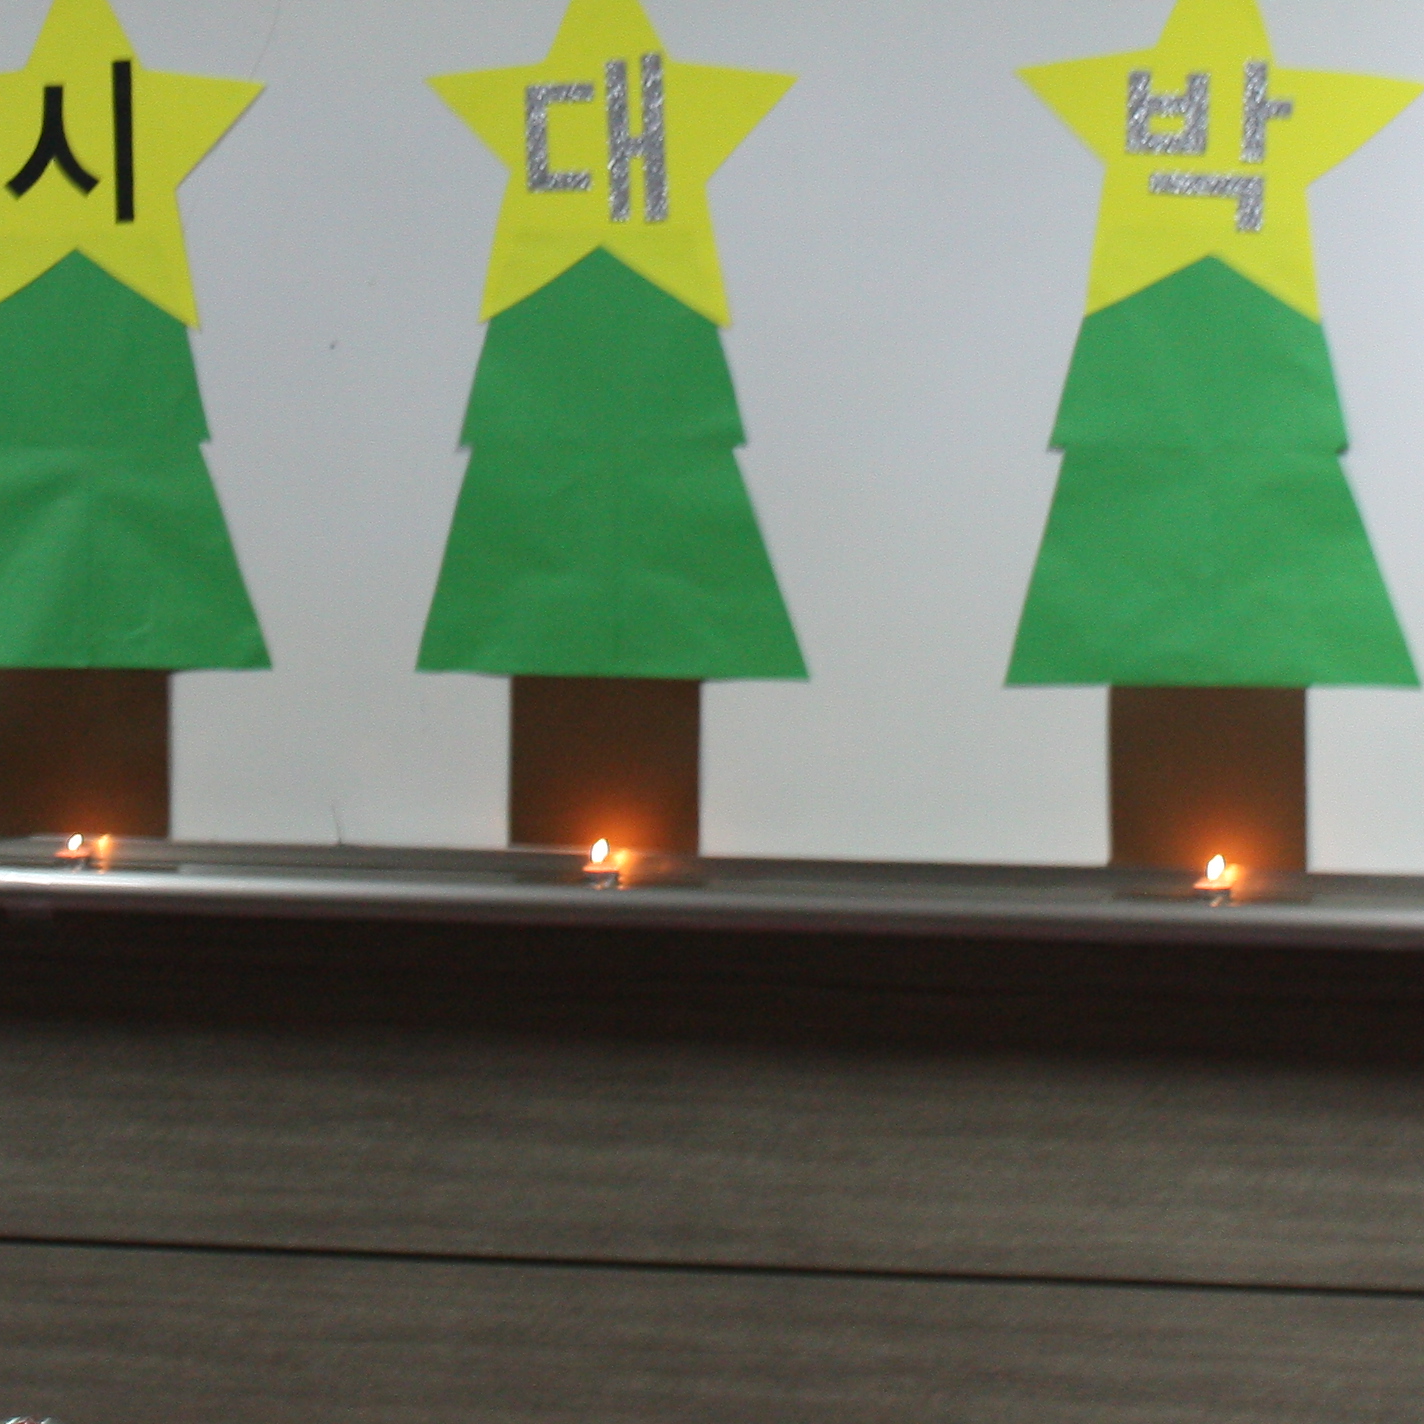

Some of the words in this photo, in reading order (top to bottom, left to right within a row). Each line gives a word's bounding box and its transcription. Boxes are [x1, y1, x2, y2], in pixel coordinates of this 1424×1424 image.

[4, 58, 136, 224] 시
[524, 51, 671, 224] 대
[1125, 59, 1294, 234] 박
